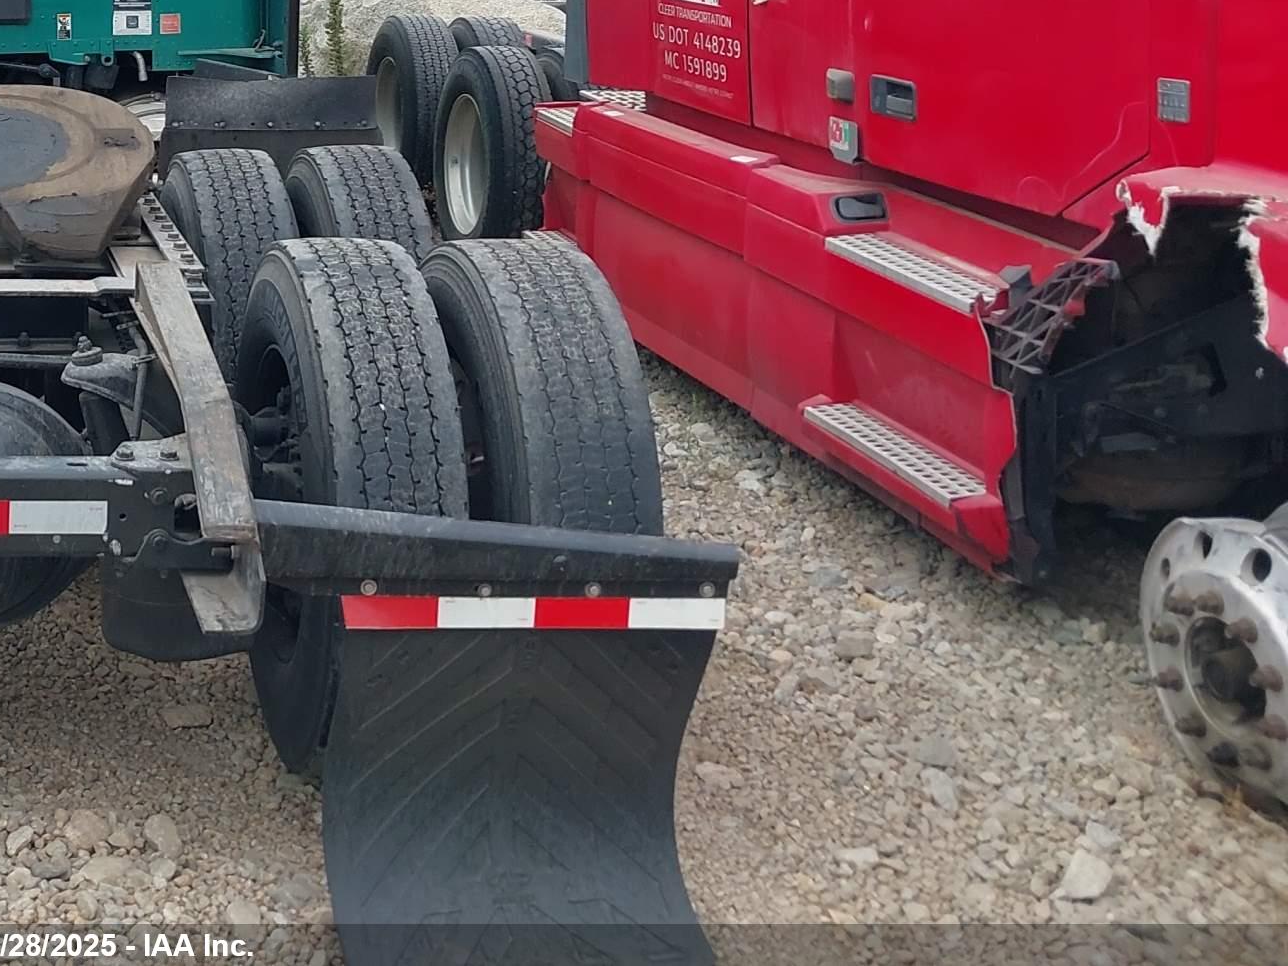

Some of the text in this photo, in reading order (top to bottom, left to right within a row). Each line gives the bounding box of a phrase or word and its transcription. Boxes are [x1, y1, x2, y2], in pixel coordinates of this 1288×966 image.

[652, 21, 742, 59] US DOT 4148239
[664, 50, 727, 83] MC 1591899
